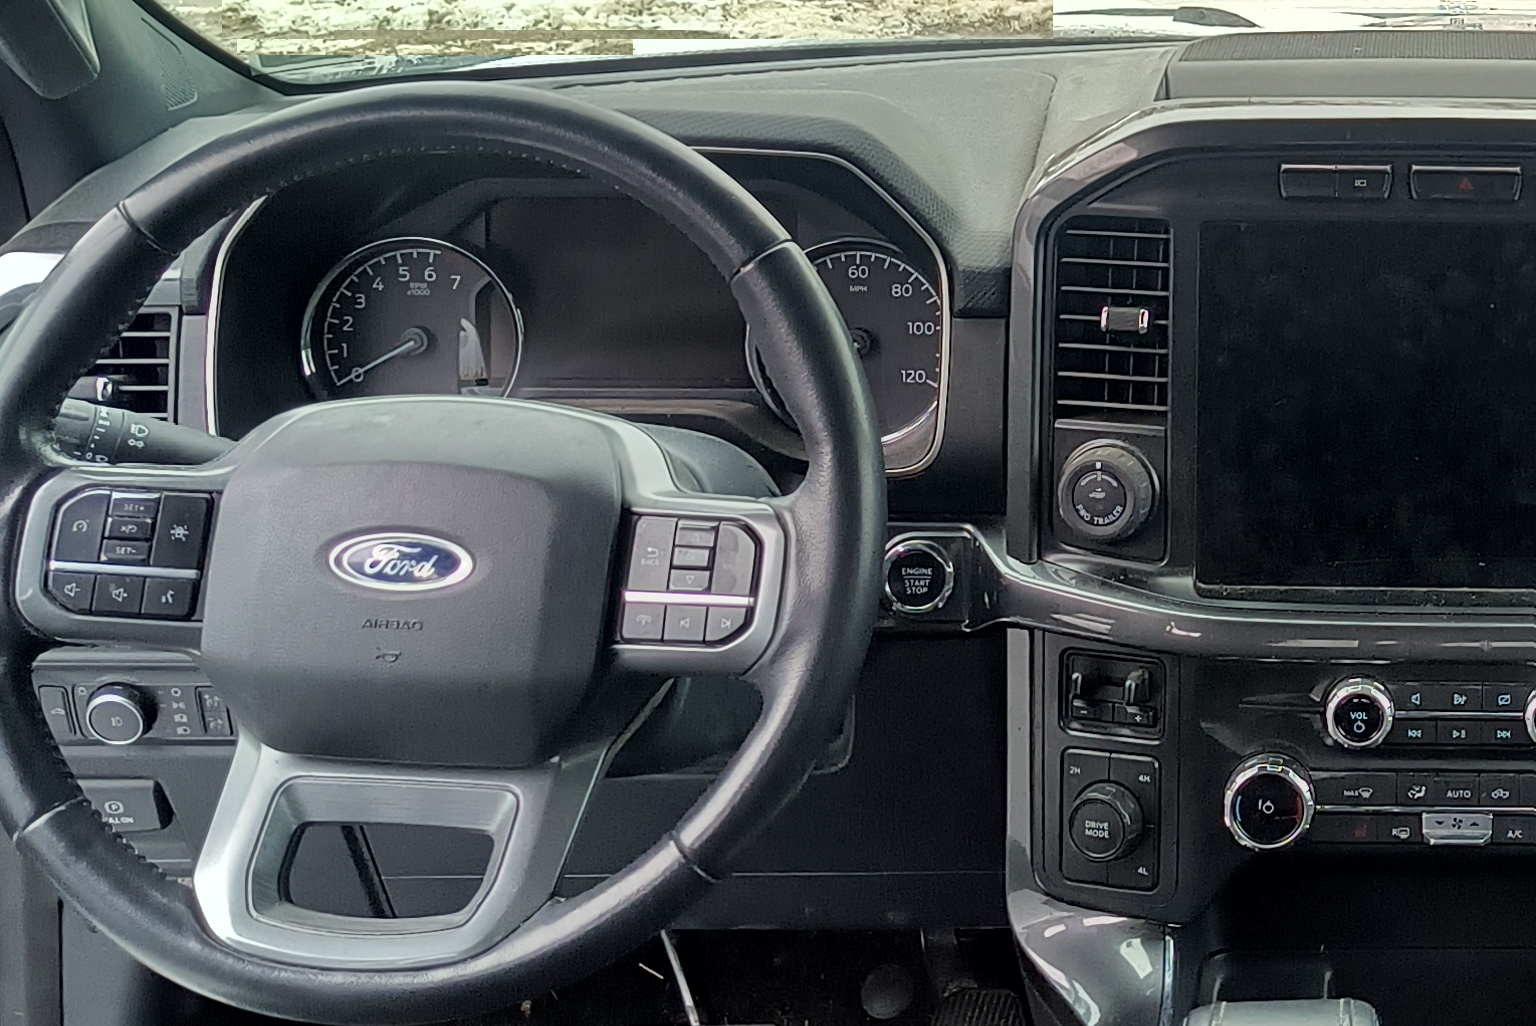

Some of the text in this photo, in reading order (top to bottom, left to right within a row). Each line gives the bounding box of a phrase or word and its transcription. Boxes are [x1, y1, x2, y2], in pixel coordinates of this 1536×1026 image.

[398, 267, 410, 281] 5
[424, 267, 437, 281] 6
[848, 265, 869, 278] 60
[372, 277, 384, 291] 4
[450, 275, 461, 289] 7
[891, 284, 913, 297] 80
[354, 294, 366, 308] 3
[342, 316, 354, 331] 2
[907, 322, 935, 335] 100
[341, 343, 347, 358] 1
[351, 366, 364, 382] 0
[901, 370, 926, 383] 120
[1076, 503, 1124, 525] PRO TRAILER
[364, 543, 439, 578] Ford
[901, 567, 933, 576] ENGINE
[904, 579, 930, 588] START
[906, 587, 929, 595] STOP
[361, 618, 424, 631] AIRBAG
[1350, 711, 1369, 720] VOL
[1069, 766, 1081, 774] 2H
[1139, 775, 1151, 783] 4H
[1446, 790, 1472, 798] AUTO
[1085, 820, 1109, 830] DRIVE
[1085, 828, 1110, 838] MODE
[1506, 829, 1523, 839] A/C
[1137, 866, 1149, 876] 4L
